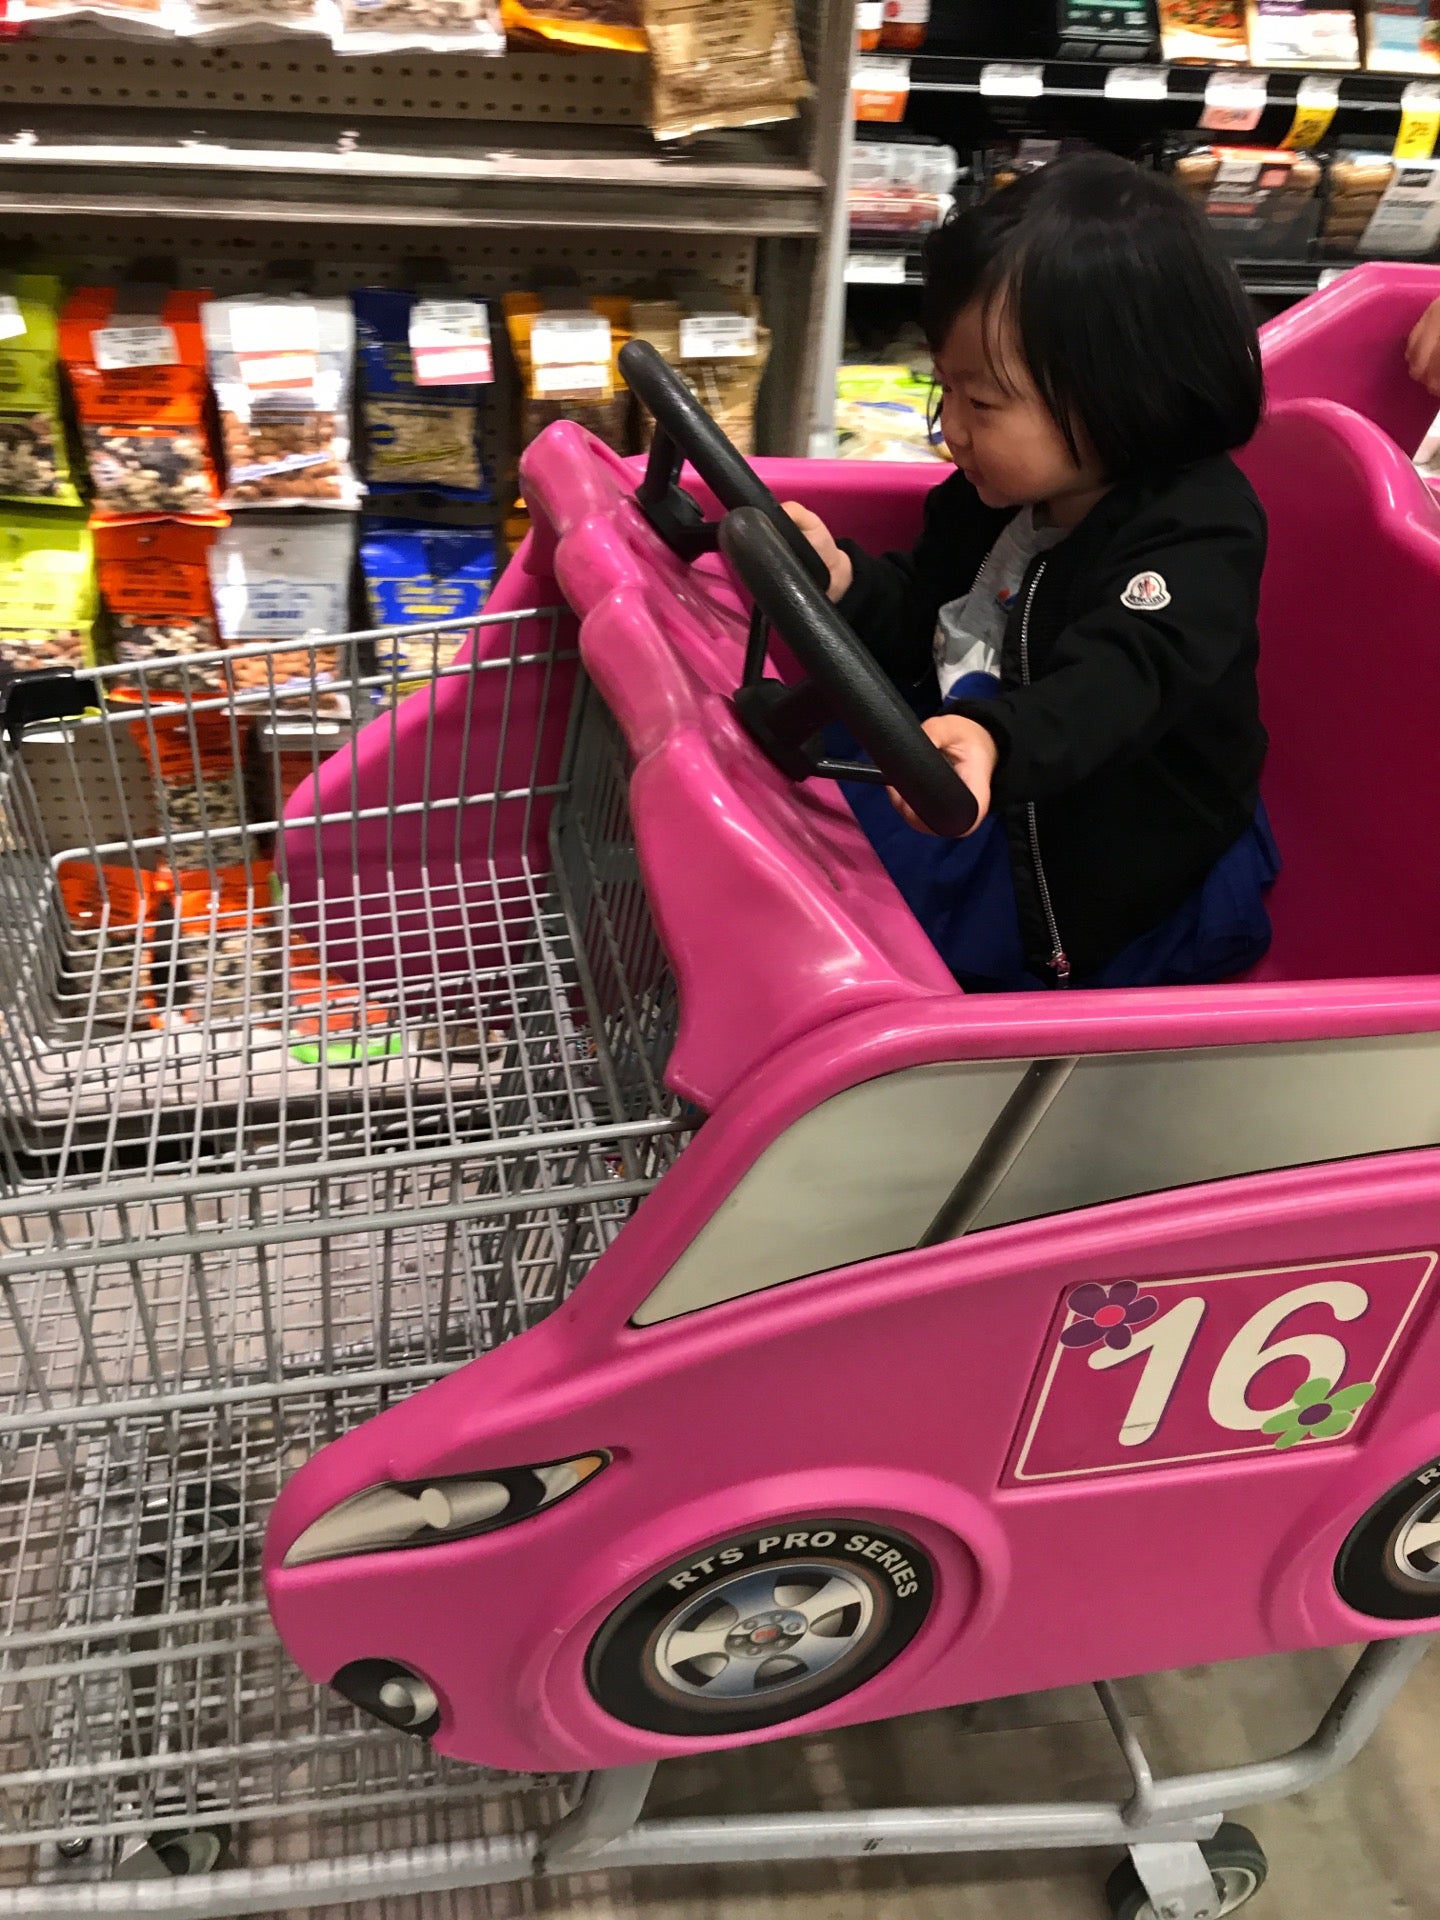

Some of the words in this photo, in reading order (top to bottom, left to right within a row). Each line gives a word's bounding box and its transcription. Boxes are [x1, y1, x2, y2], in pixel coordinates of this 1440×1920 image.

[1087, 1281, 1369, 1447] 16
[668, 1547, 744, 1591] RTS
[758, 1530, 836, 1555] PRO
[844, 1534, 919, 1598] SERIES
